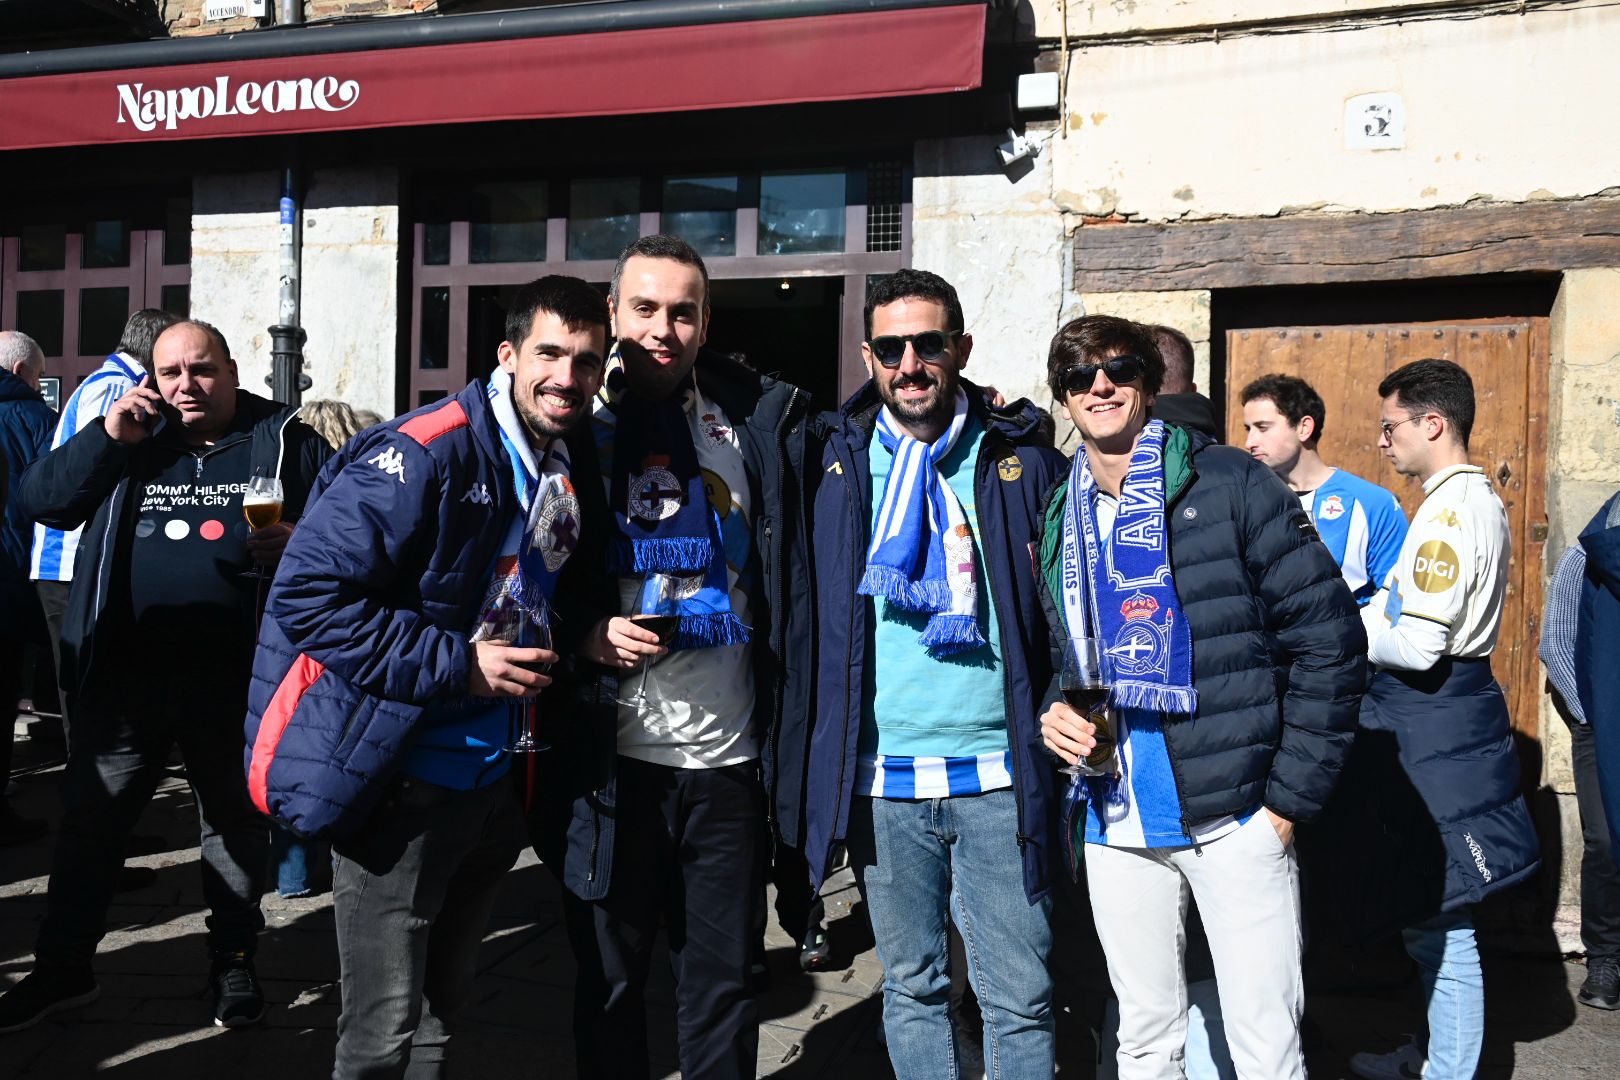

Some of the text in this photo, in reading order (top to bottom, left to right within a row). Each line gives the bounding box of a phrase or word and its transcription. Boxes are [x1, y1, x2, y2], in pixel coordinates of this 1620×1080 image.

[209, 6, 245, 17] ACCESORIO
[145, 484, 191, 496] OMMY
[170, 496, 199, 506] York
[203, 496, 230, 507] City
[1064, 541, 1078, 589] SUPER
[1415, 556, 1455, 580] DIGI
